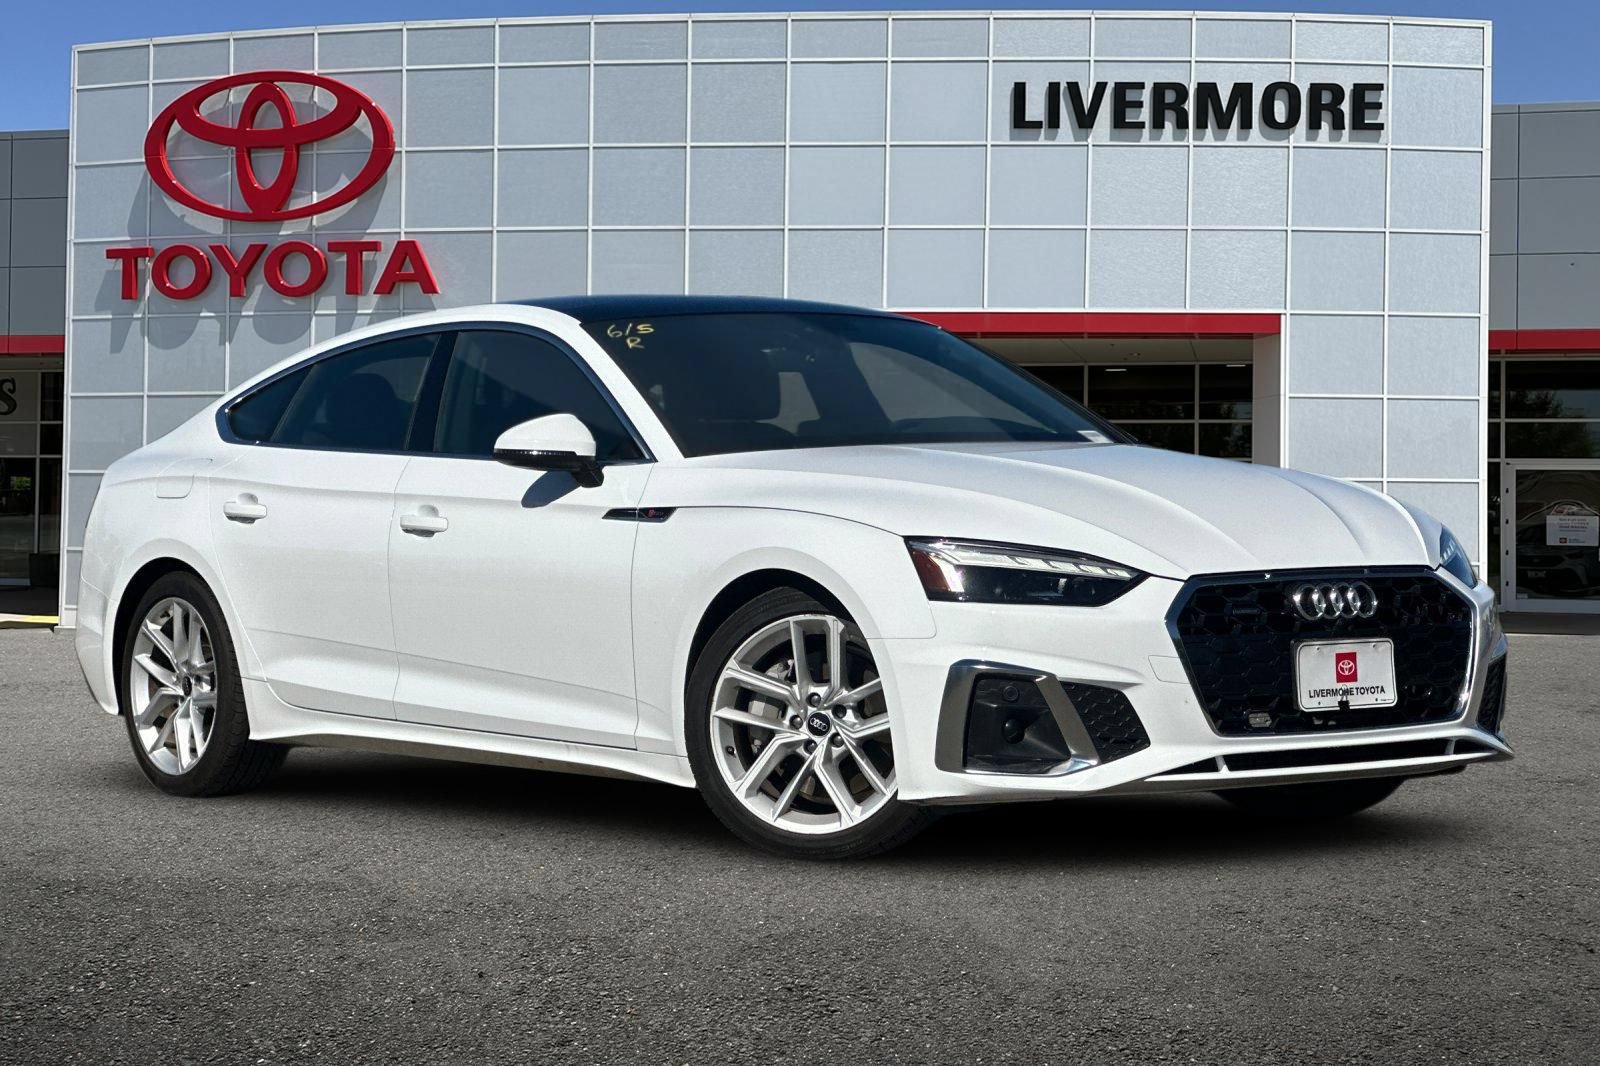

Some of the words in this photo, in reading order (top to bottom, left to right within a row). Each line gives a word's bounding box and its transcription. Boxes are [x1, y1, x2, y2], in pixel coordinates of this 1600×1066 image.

[1012, 81, 1385, 130] LIVERMORE
[106, 239, 440, 300] TOYOTA
[1355, 685, 1386, 697] TOYOTA
